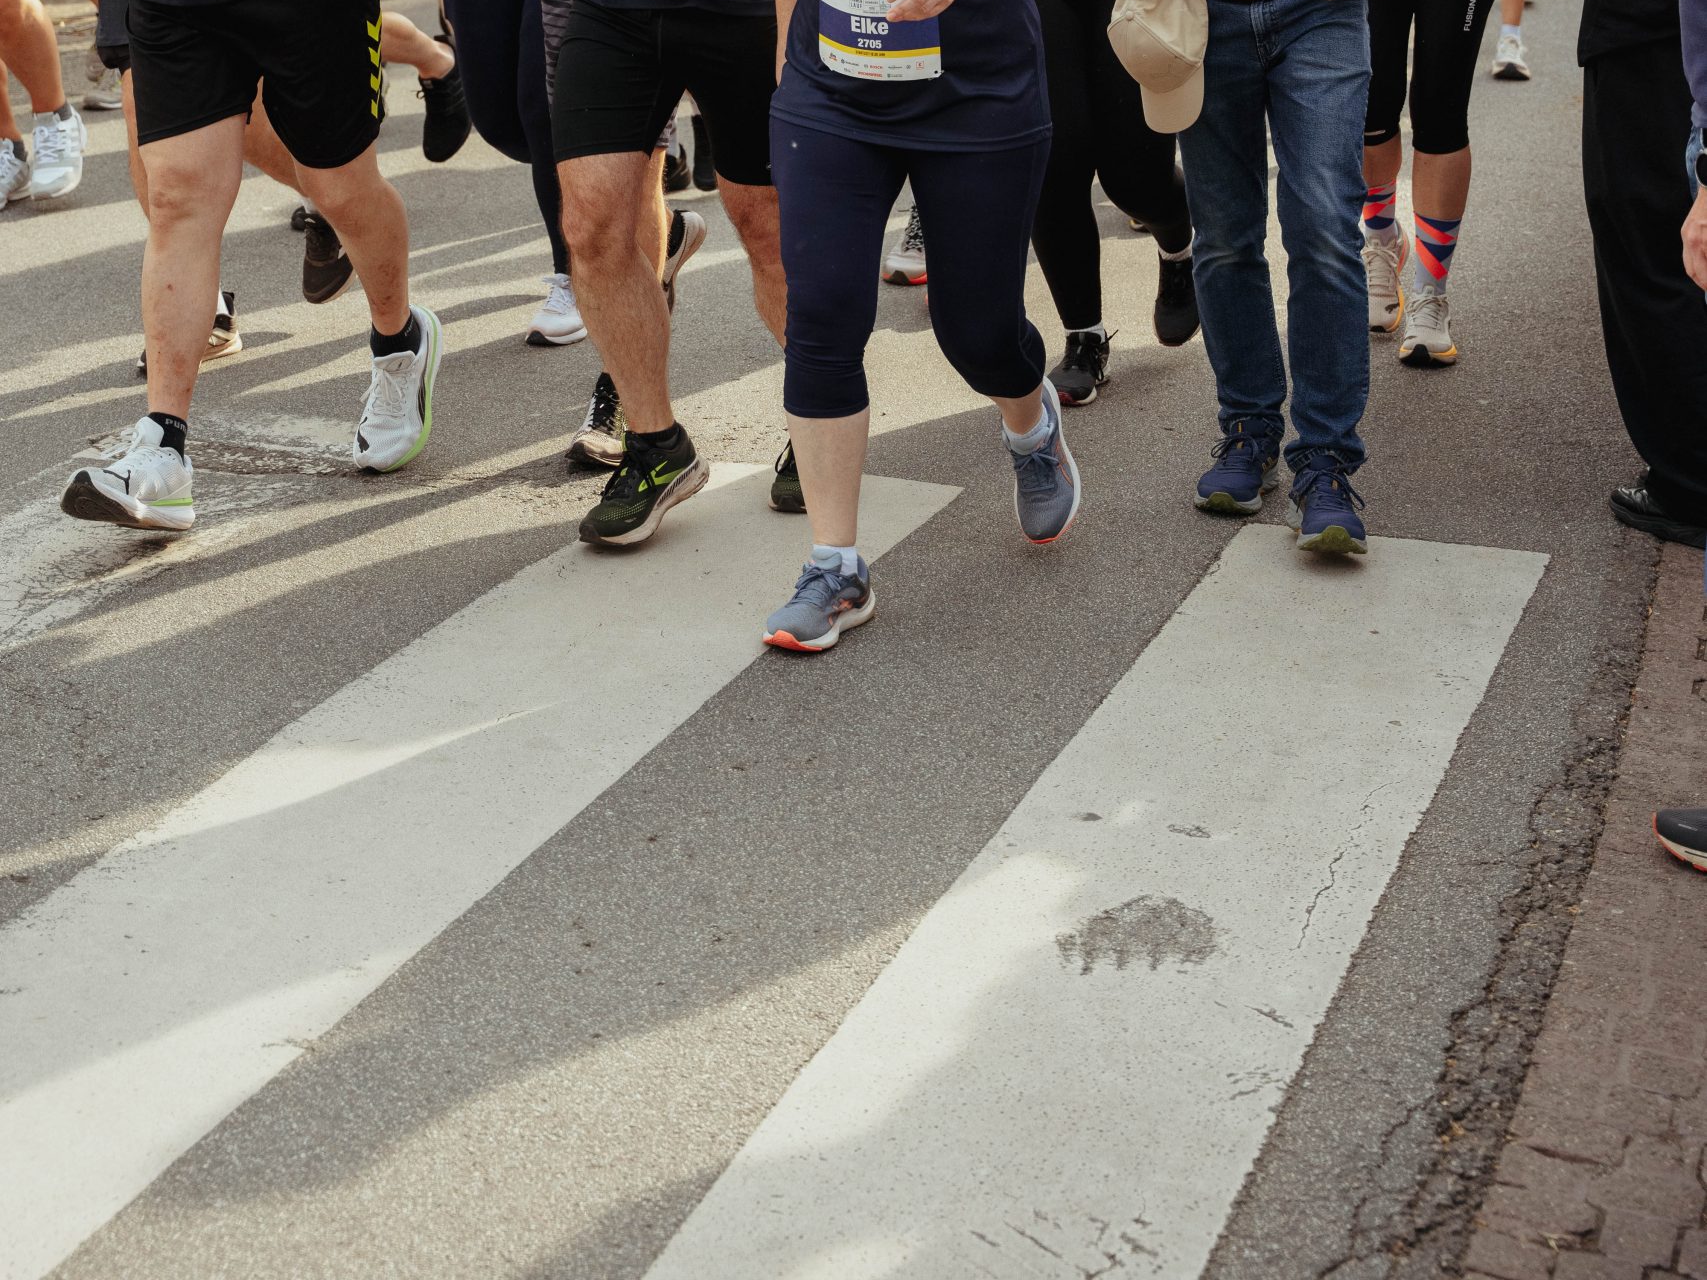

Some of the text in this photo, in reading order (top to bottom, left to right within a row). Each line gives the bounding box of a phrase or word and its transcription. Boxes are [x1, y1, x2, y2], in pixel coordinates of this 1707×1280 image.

[850, 15, 889, 35] Elke
[1463, 0, 1477, 31] FUSION
[857, 38, 882, 49] 2705
